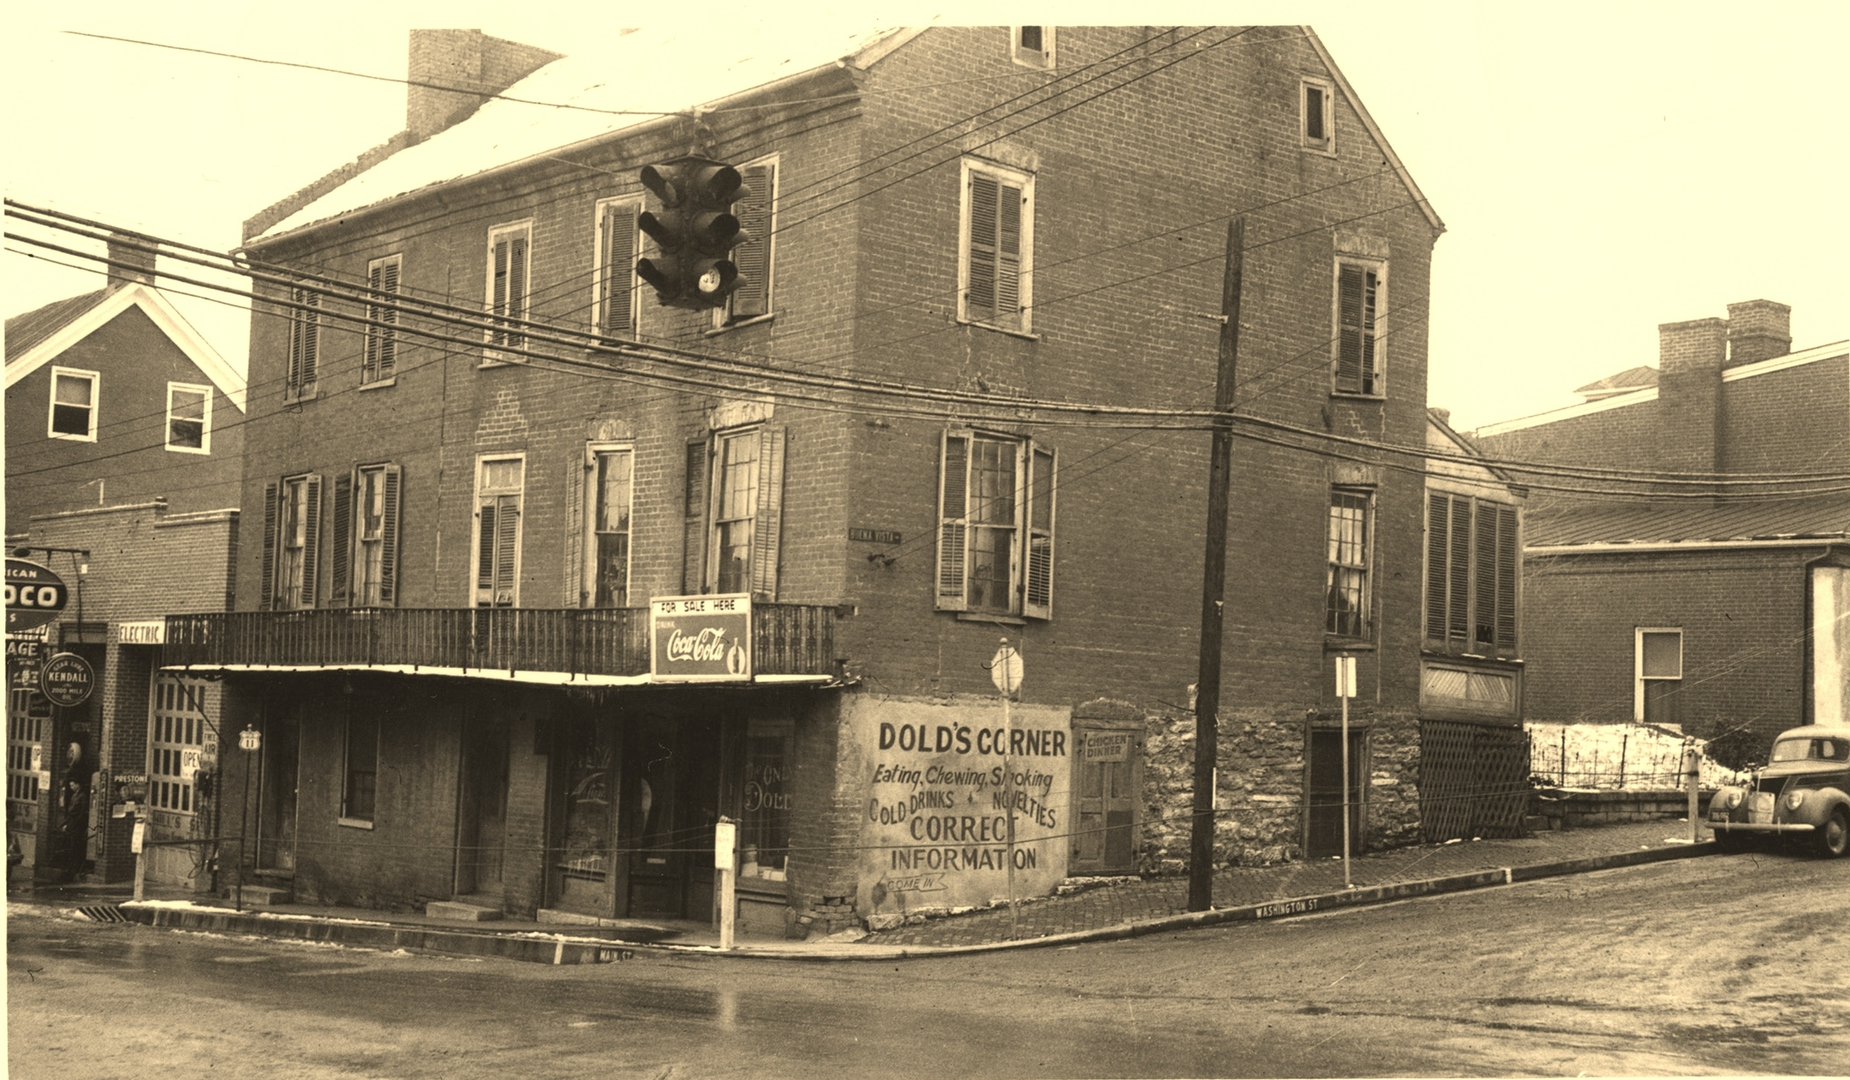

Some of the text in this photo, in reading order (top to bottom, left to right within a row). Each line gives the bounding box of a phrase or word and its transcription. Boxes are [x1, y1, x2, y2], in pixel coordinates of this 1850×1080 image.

[661, 600, 735, 613] FOR SALE HERE
[119, 626, 159, 642] ELECTRIC
[667, 628, 727, 661] Coca-Cola
[48, 672, 88, 682] KENDALL
[246, 739, 254, 748] 11
[879, 721, 1066, 756] DOLD'S CORNER
[1087, 735, 1127, 748] CHICKEN
[203, 743, 216, 756] AIR
[1087, 746, 1121, 758] DINNER
[869, 798, 907, 826] COLD
[910, 790, 954, 815] DRINKS
[892, 847, 1036, 871] INFORMATON
[887, 878, 935, 890] COME IN
[1256, 899, 1318, 919] WASHINGTON ST
